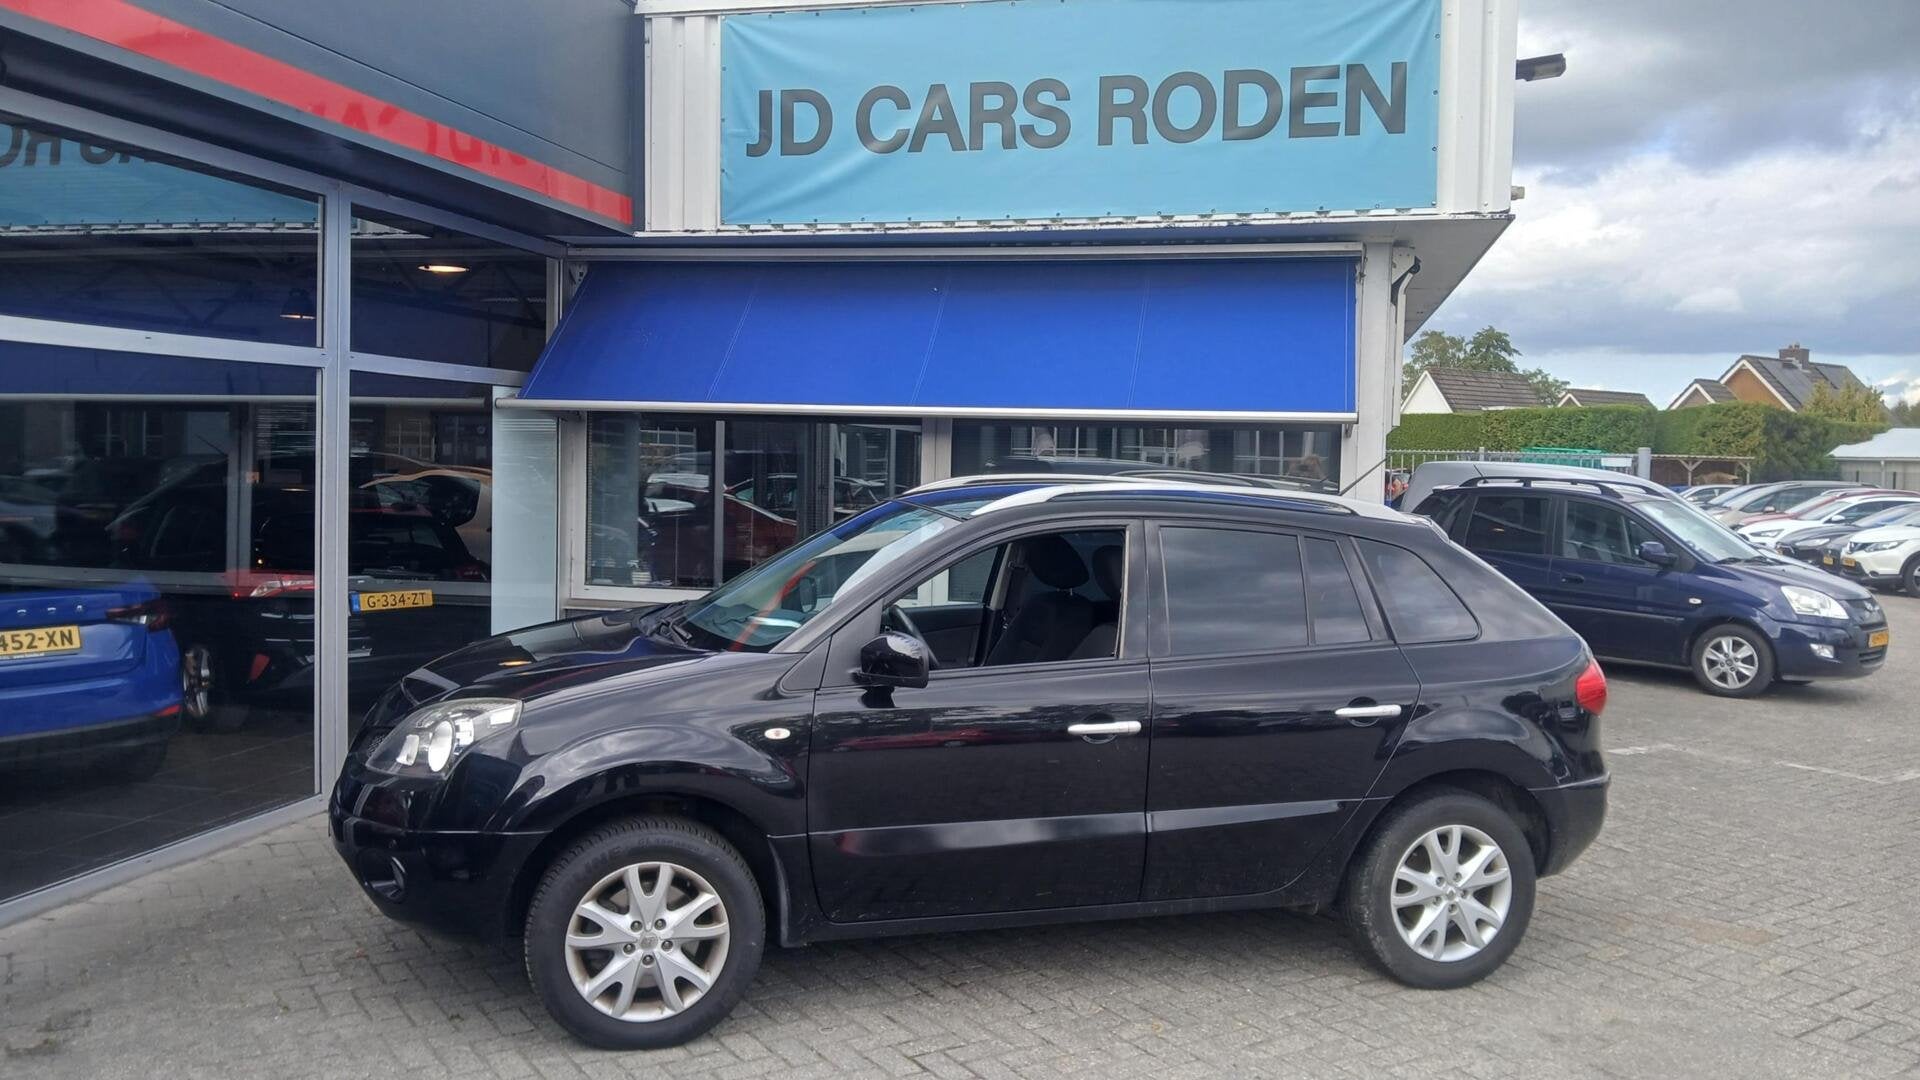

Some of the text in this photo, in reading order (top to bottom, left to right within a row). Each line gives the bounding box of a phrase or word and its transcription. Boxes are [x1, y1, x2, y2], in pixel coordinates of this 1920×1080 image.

[746, 63, 1407, 157] JD CARS RODEN
[367, 592, 426, 609] G-334-ZT
